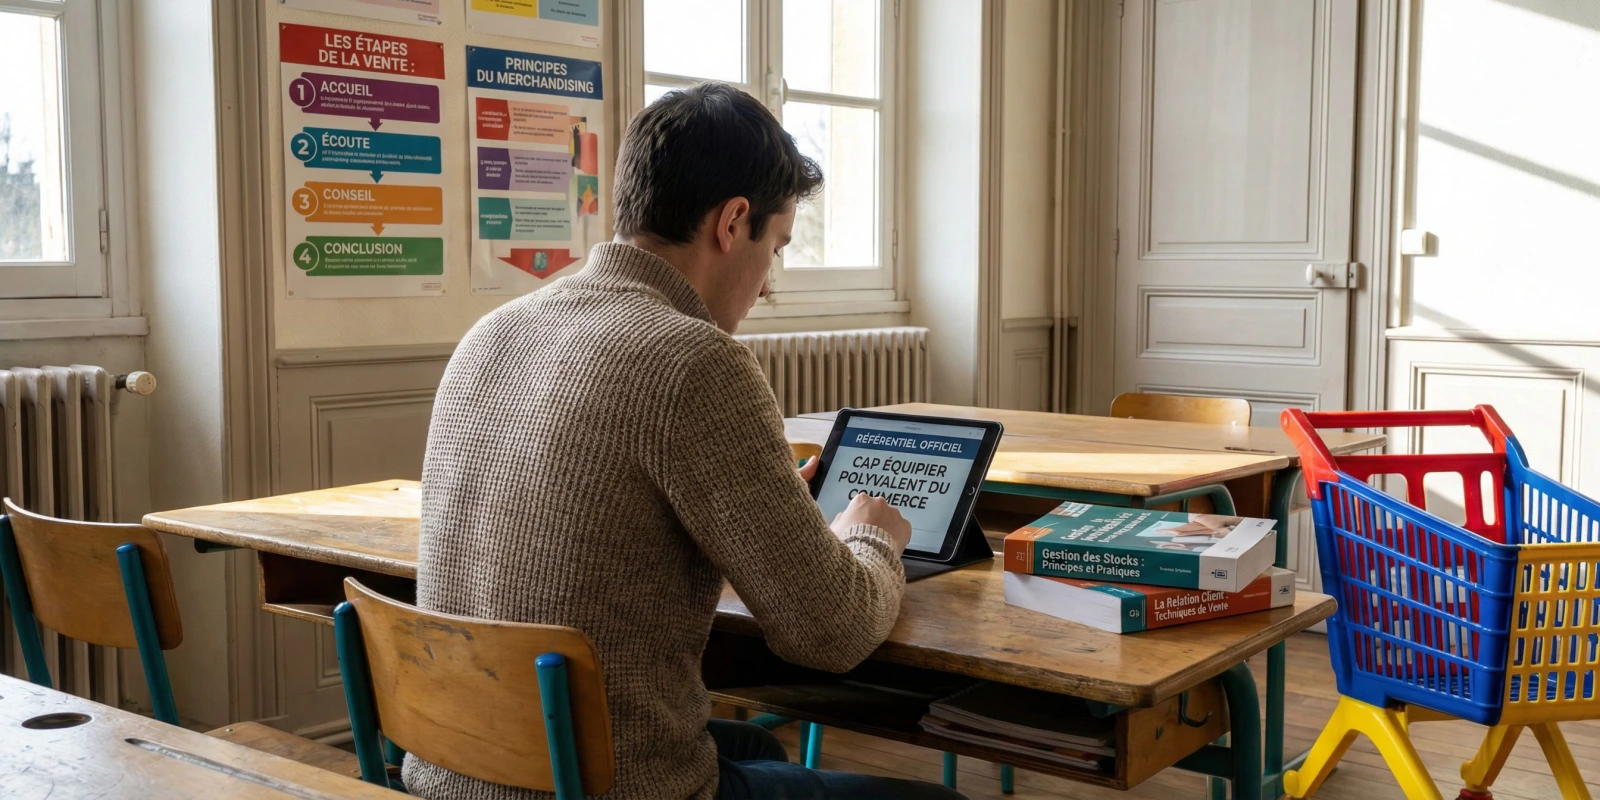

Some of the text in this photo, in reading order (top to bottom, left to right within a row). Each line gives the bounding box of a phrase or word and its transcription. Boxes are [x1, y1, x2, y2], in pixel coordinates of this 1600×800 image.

[324, 33, 408, 56] LES ÉTAPES
[318, 49, 415, 73] DE LA VENTE :
[505, 56, 567, 76] PRINCIPES
[320, 80, 373, 97] ACCUEIL
[476, 69, 594, 94] DU MERCHANDISING
[297, 84, 305, 100] 1
[298, 139, 309, 155] 2
[321, 132, 370, 149] ÉCOUTE
[299, 194, 310, 210] 3
[323, 188, 376, 201] CONSEIL
[299, 248, 311, 264] 4
[324, 242, 403, 255] CONCLUSION
[855, 432, 963, 453] RÉFÉRENTIEL OFFICIEL
[852, 455, 948, 478] CAP ÉQUIPIER
[838, 470, 951, 495] POLYVALENT DU
[1042, 548, 1145, 567] Gestion des Stocks :
[1042, 560, 1140, 578] Principes et Pratiques
[1154, 599, 1165, 610] La
[1166, 593, 1200, 608] Relation
[1201, 591, 1225, 603] Client
[1154, 602, 1229, 621] Techniques de Vente
